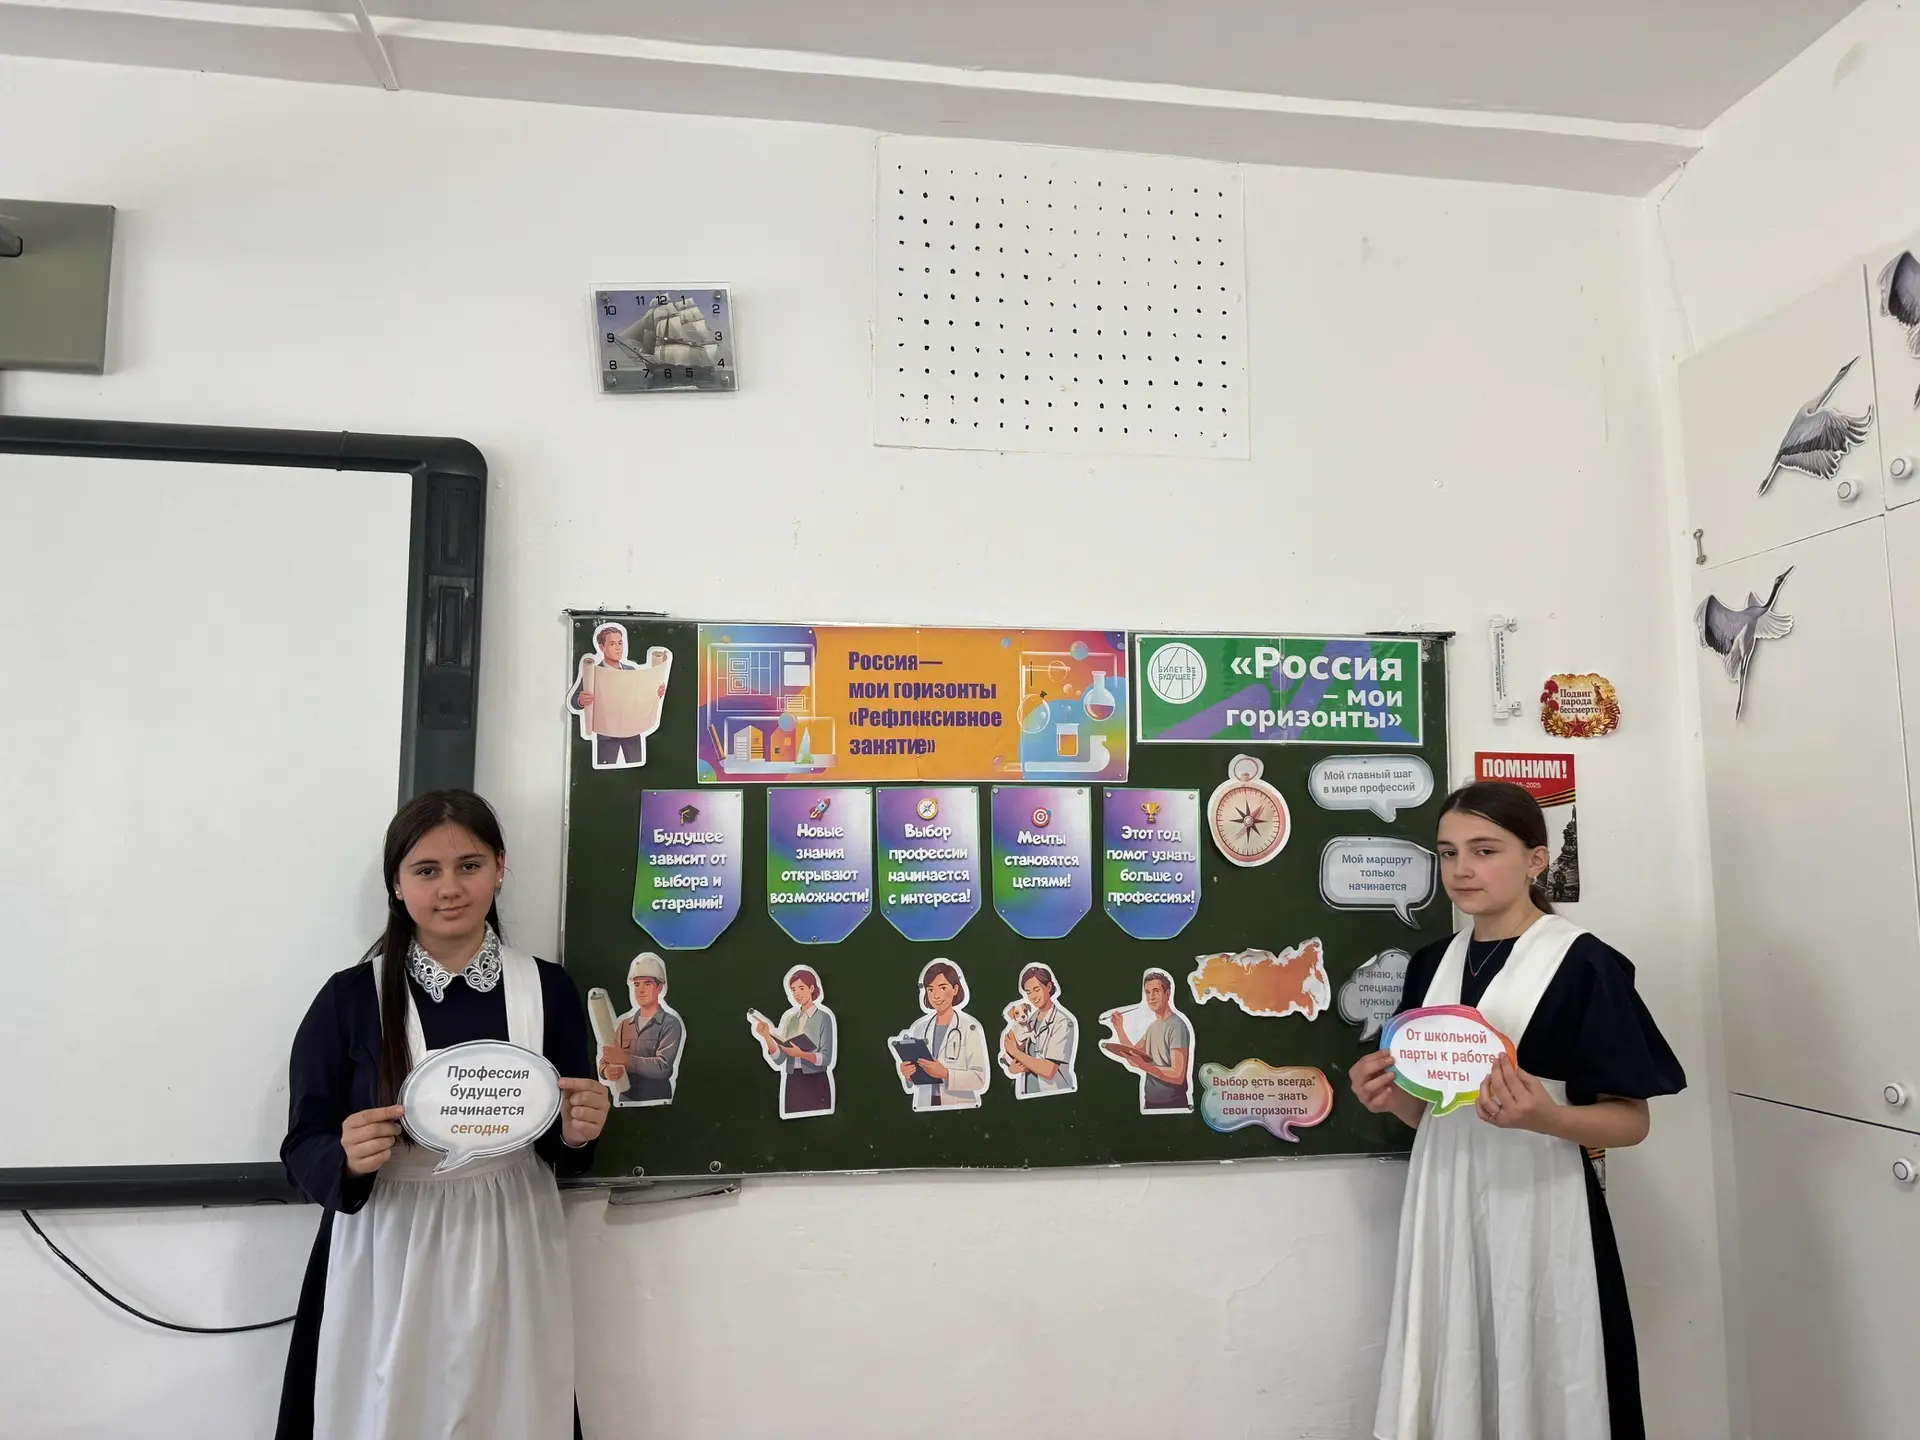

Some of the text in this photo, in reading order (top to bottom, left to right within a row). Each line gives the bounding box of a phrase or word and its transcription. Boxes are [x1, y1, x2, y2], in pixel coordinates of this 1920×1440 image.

[636, 296, 645, 306] 11
[656, 296, 668, 306] 12
[681, 296, 686, 306] 1
[604, 306, 617, 316] 10
[712, 304, 720, 314] 2
[607, 333, 615, 343] 9
[714, 331, 723, 341] 3
[609, 360, 617, 370] 8
[717, 358, 725, 368] 4
[643, 369, 650, 379] 7
[664, 368, 672, 378] 6
[686, 368, 693, 378] 5
[1230, 646, 1402, 682] «Россия
[849, 682, 996, 700] мои горизонты
[1560, 688, 1592, 698] Подвиг
[1348, 689, 1402, 707] мои
[1561, 698, 1592, 707] народа
[1226, 708, 1402, 734] горизонты»
[849, 738, 936, 755] занятие»
[1324, 769, 1412, 780] Мой главный шаг
[1482, 758, 1568, 779] ПОМНИМ!
[1324, 782, 1415, 795] в мире профессий
[796, 823, 844, 838] Новые
[904, 824, 952, 840] Выбор
[1122, 826, 1182, 842] Этот год
[653, 829, 724, 846] Будущее
[1017, 831, 1066, 846] Мечты
[649, 854, 727, 866] зависит от
[796, 848, 844, 860] знания
[888, 848, 968, 864] профессии
[1106, 850, 1196, 864] помог узнать
[1342, 854, 1413, 866] Мой маршрут
[1004, 854, 1080, 867] становятся
[781, 870, 858, 884] открывают
[888, 870, 970, 882] начинается
[1120, 868, 1183, 883] больше о
[1360, 869, 1395, 878] только
[654, 874, 722, 891] выбора и
[1012, 873, 1072, 889] целями!
[1349, 882, 1407, 891] начинается
[770, 888, 870, 904] возможности!
[888, 888, 971, 907] с интереса!
[1108, 890, 1196, 906] профессиях!
[651, 894, 724, 914] стараний!
[1358, 970, 1364, 978] Я
[1366, 971, 1394, 980] знаю,
[1360, 999, 1394, 1008] нужны
[1374, 1012, 1393, 1021] стр
[1406, 1028, 1487, 1044] От школьной
[1400, 1048, 1496, 1064] парты к работе
[447, 1065, 530, 1081] Профессия
[1427, 1069, 1470, 1082] мечты
[1213, 1076, 1248, 1088] Выбор
[1251, 1078, 1274, 1086] есть
[450, 1084, 522, 1099] будущего
[1221, 1091, 1264, 1100] Главное
[1278, 1092, 1308, 1100] знать
[440, 1105, 524, 1116] начинается
[1222, 1107, 1308, 1117] свои горизонты
[450, 1124, 509, 1136] сегодня
